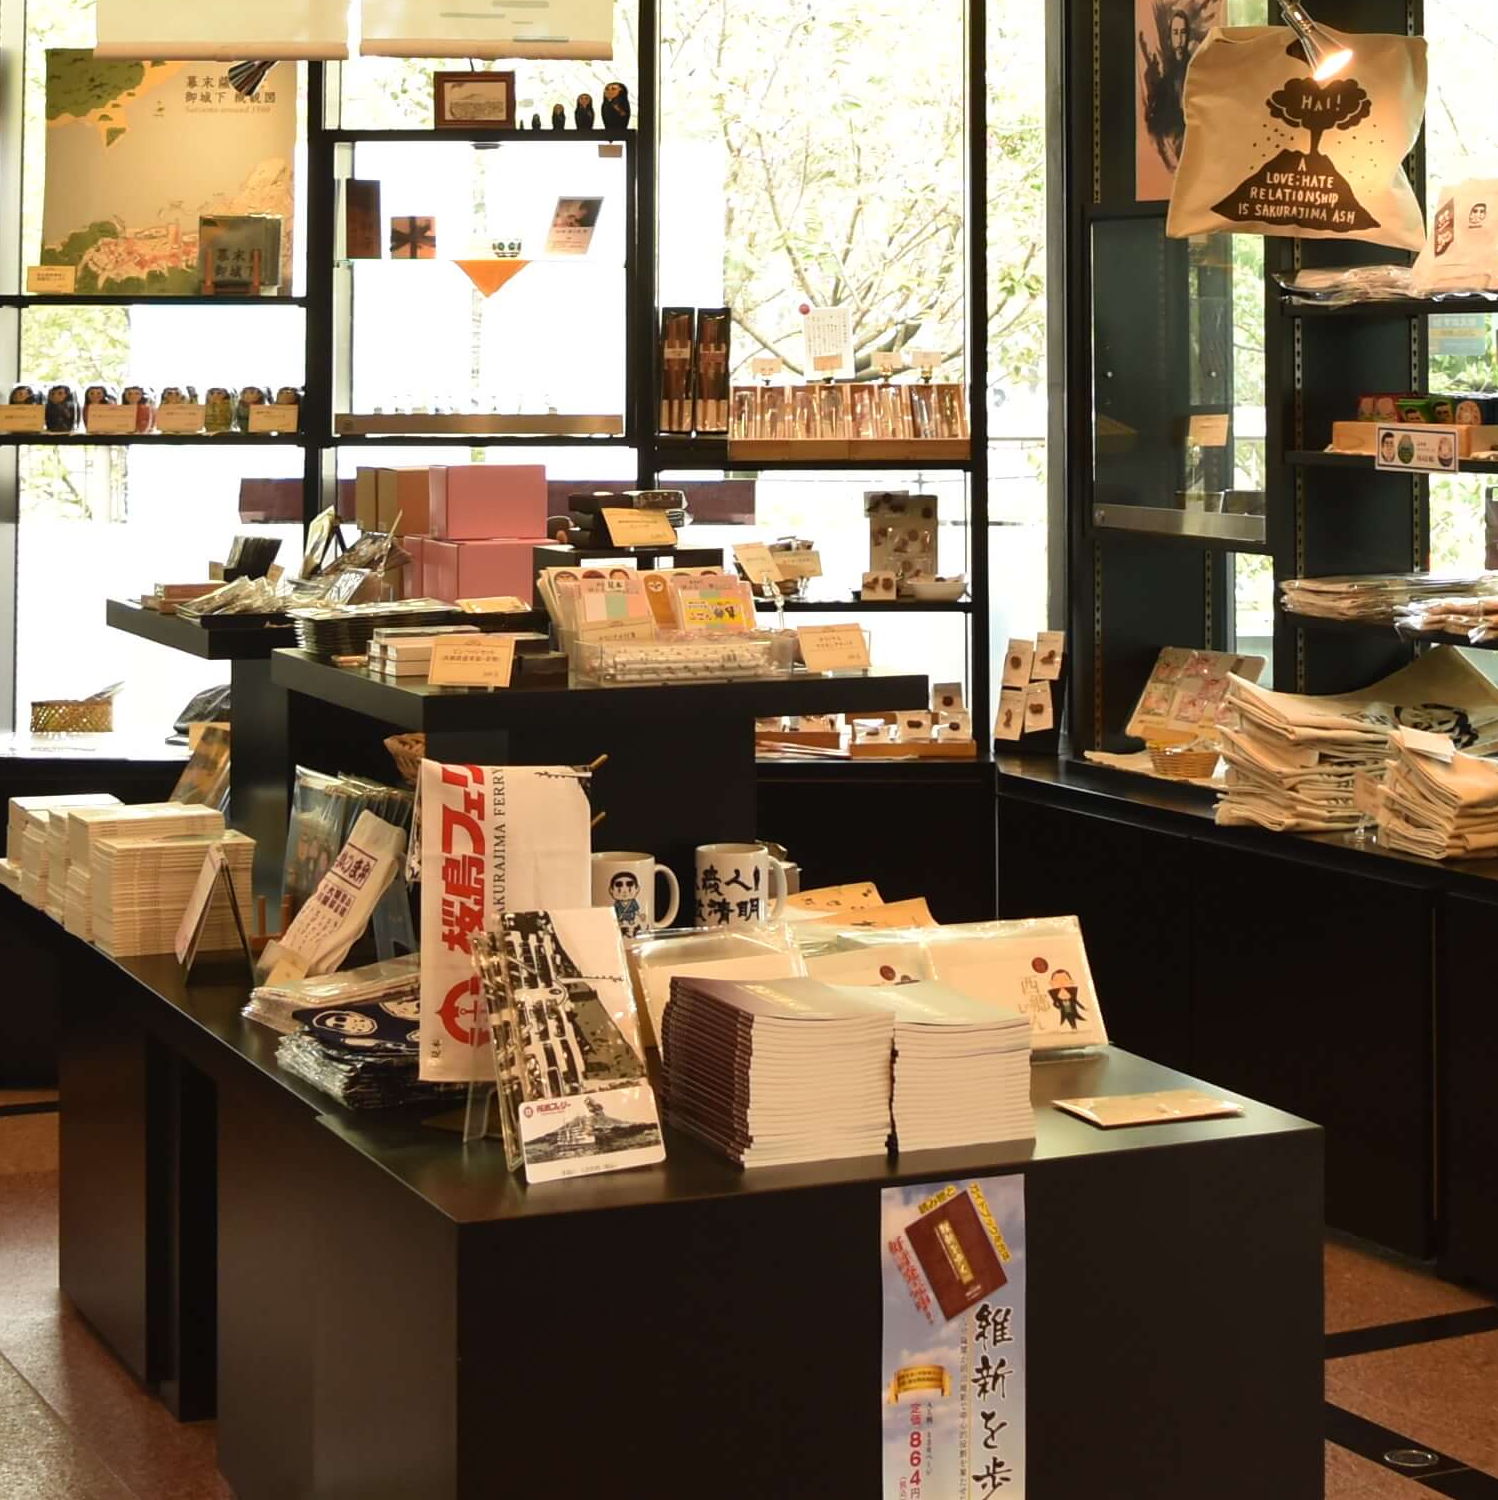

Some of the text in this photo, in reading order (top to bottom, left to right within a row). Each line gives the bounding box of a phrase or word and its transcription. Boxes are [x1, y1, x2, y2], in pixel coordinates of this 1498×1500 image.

[1301, 94, 1341, 112] HAI!
[1298, 157, 1306, 172] A
[1250, 186, 1339, 207] RELATIONSHIP
[1238, 203, 1356, 225] IS SAKURAJIMA ASH
[492, 767, 507, 915] AKURAJIMA FERRY
